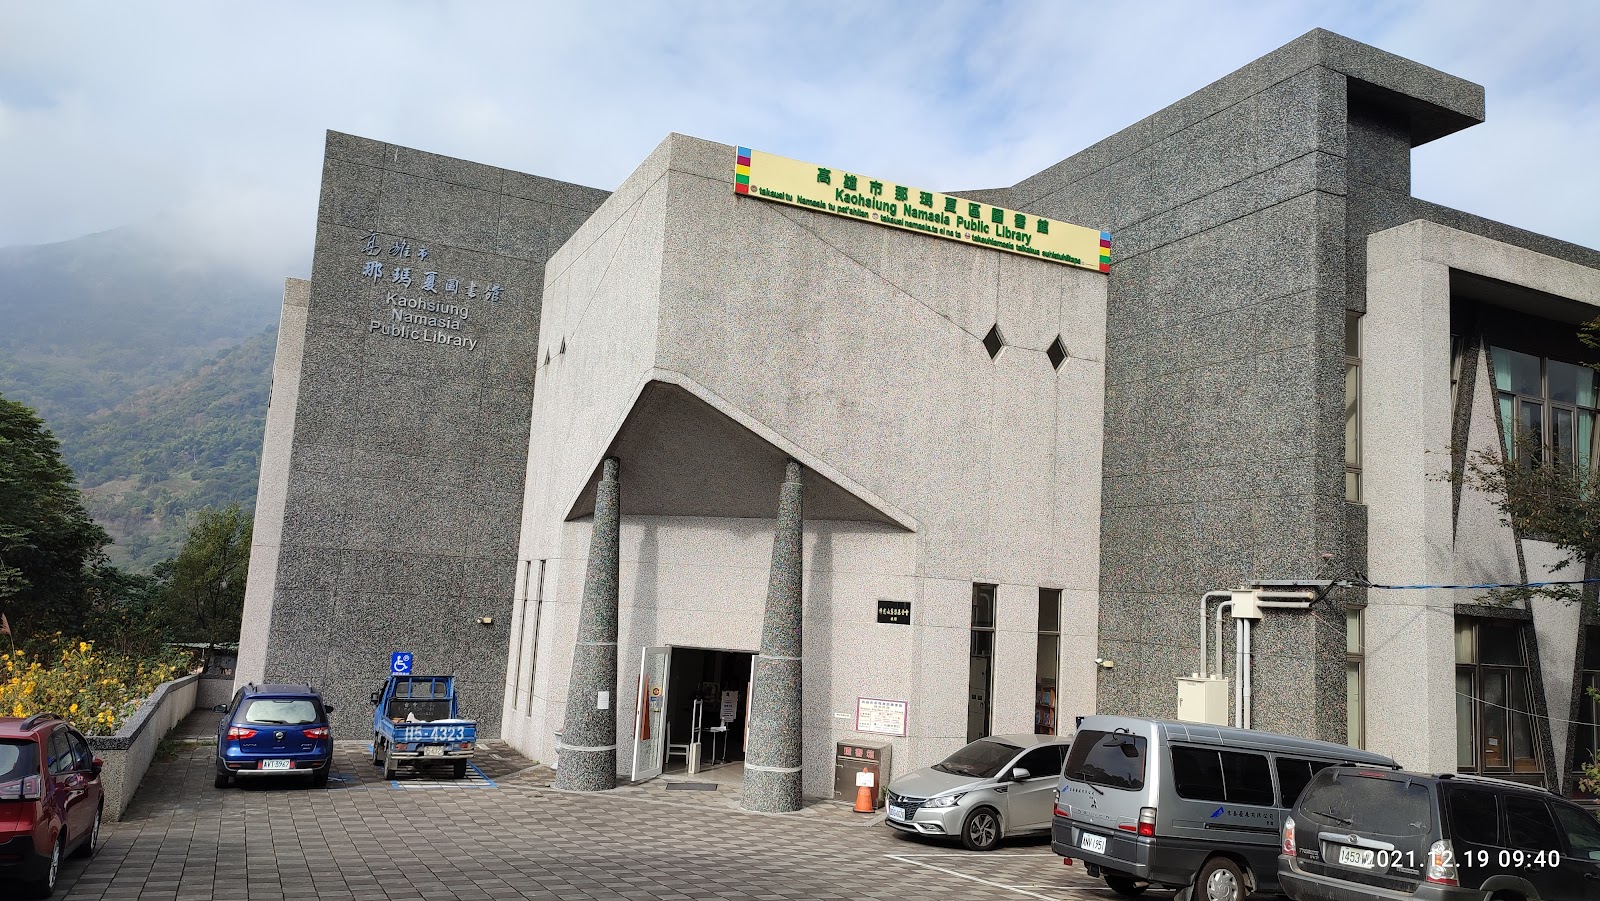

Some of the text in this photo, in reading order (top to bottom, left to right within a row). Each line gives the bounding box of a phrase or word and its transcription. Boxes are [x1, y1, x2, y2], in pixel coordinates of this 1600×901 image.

[816, 167, 1049, 235] 高雄市那瑪夏區圖書館
[835, 188, 1032, 246] Kaohsiung Namasia Public Library
[361, 230, 430, 261] 高雄市
[363, 261, 504, 301] 那瑪夏圖書館
[386, 292, 469, 320] Kaohsiung
[392, 308, 461, 331] Namasia
[370, 320, 478, 351] Public Library
